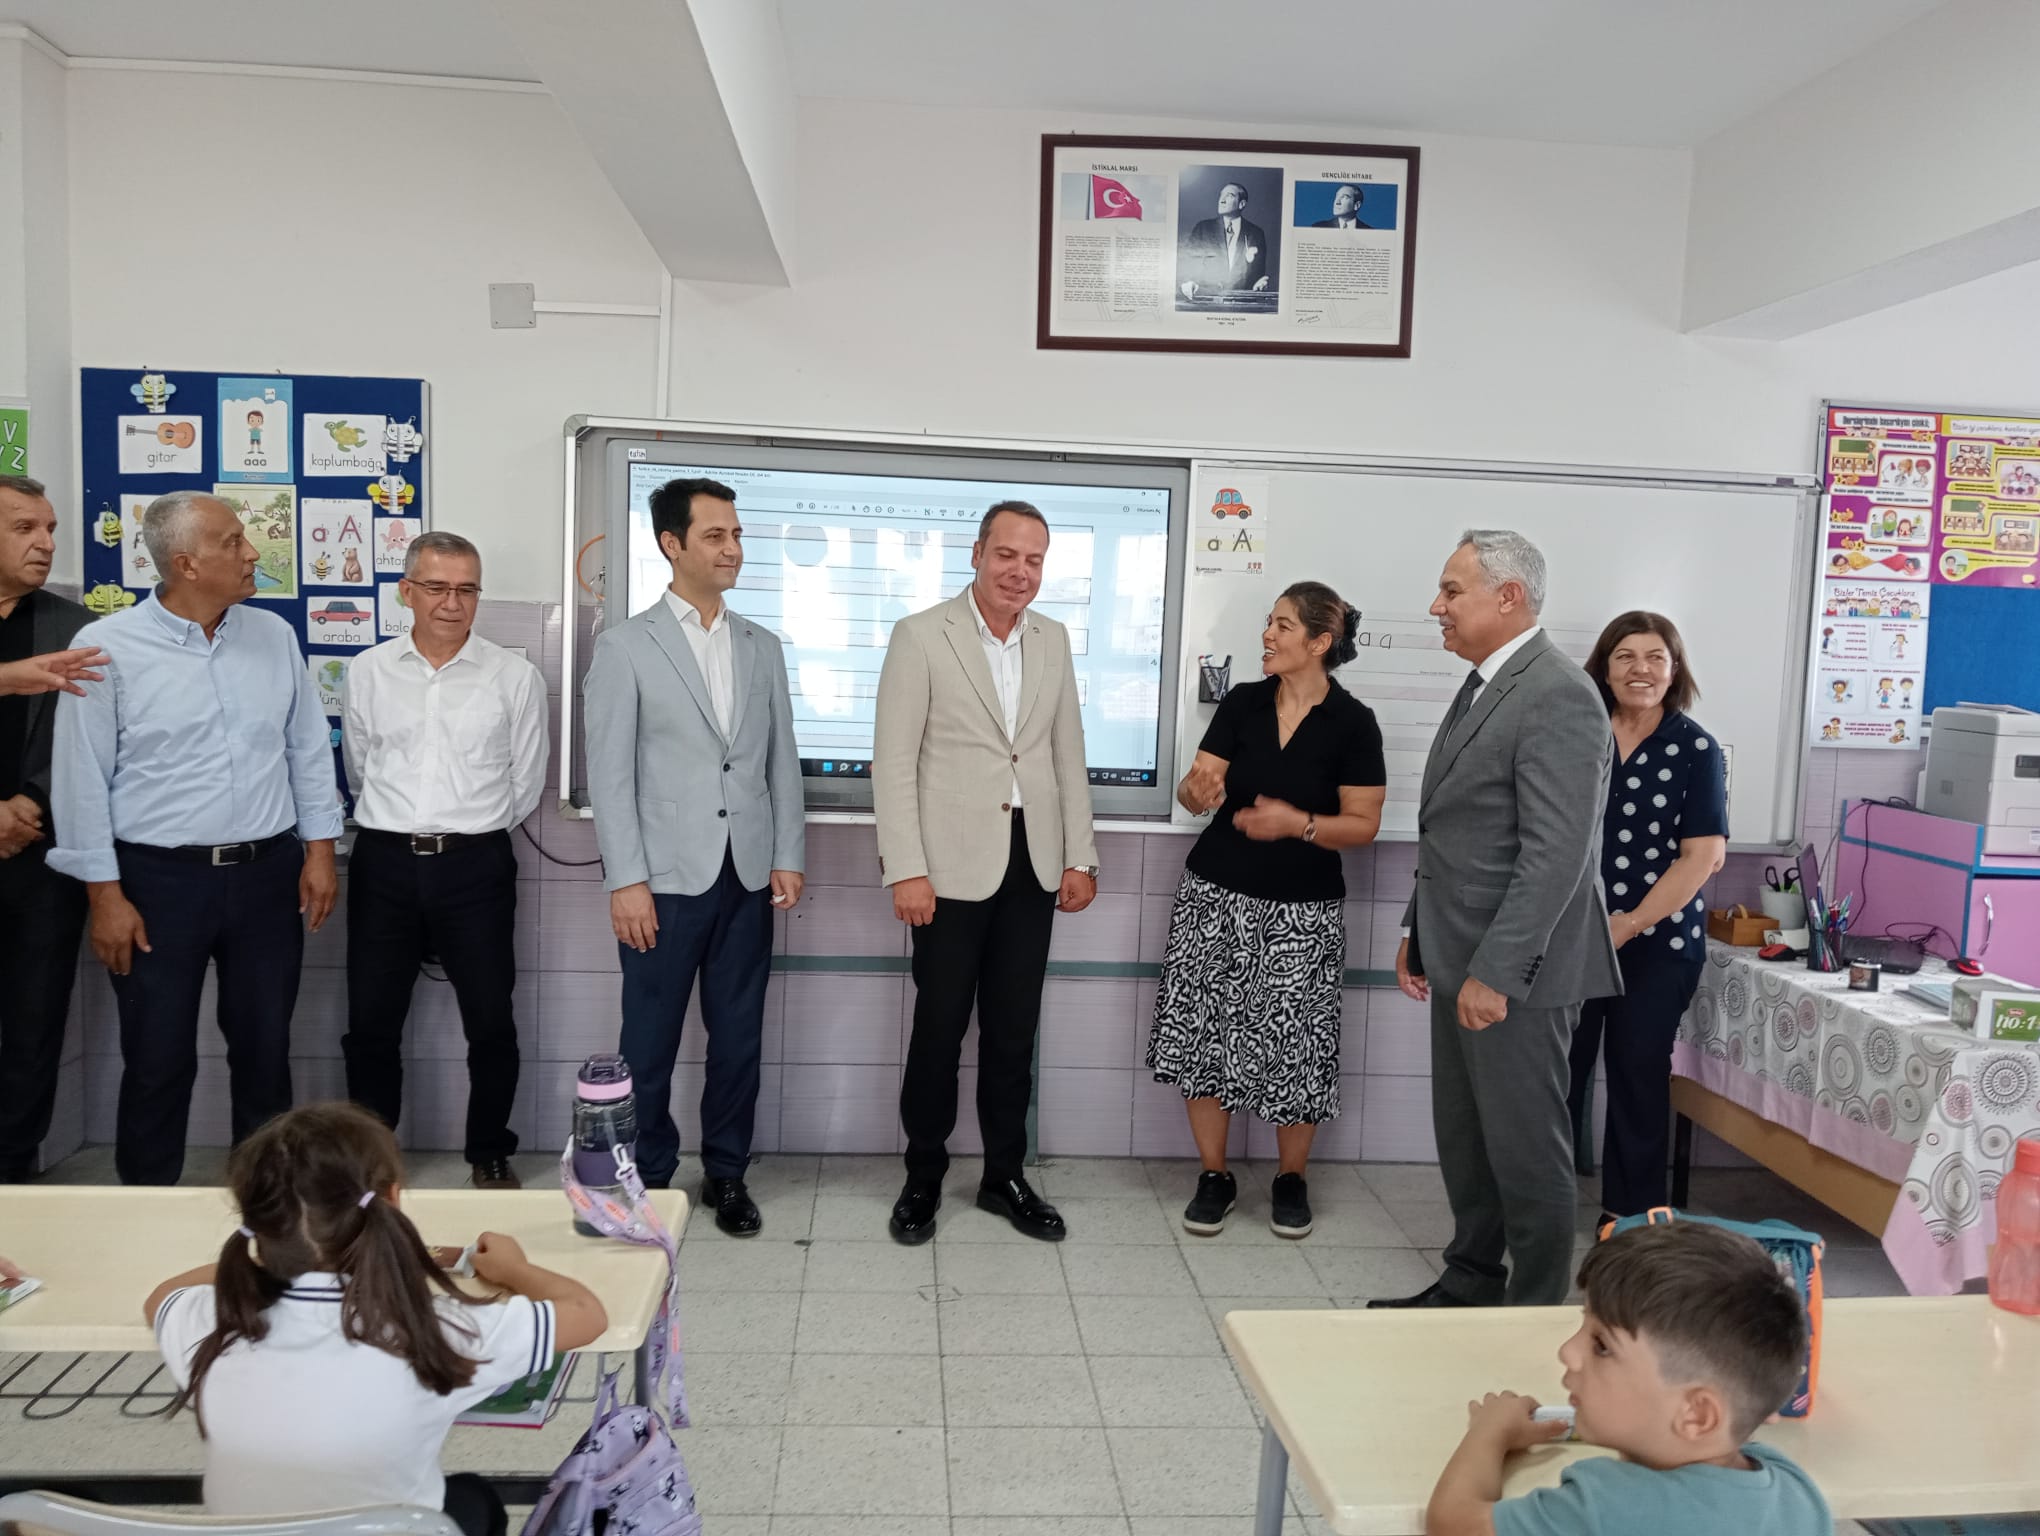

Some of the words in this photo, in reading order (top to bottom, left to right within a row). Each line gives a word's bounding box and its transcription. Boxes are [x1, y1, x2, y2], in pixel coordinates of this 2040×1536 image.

[3, 419, 18, 444] V
[11, 445, 26, 471] Z
[147, 453, 177, 468] gitar
[244, 457, 268, 466] aaa
[311, 453, 383, 472] kaplumbağa
[312, 527, 326, 542] a
[338, 515, 362, 543] A
[1208, 539, 1219, 551] a
[1232, 528, 1252, 552] A
[323, 629, 360, 642] araba
[1996, 1014, 2037, 1030] no:1
